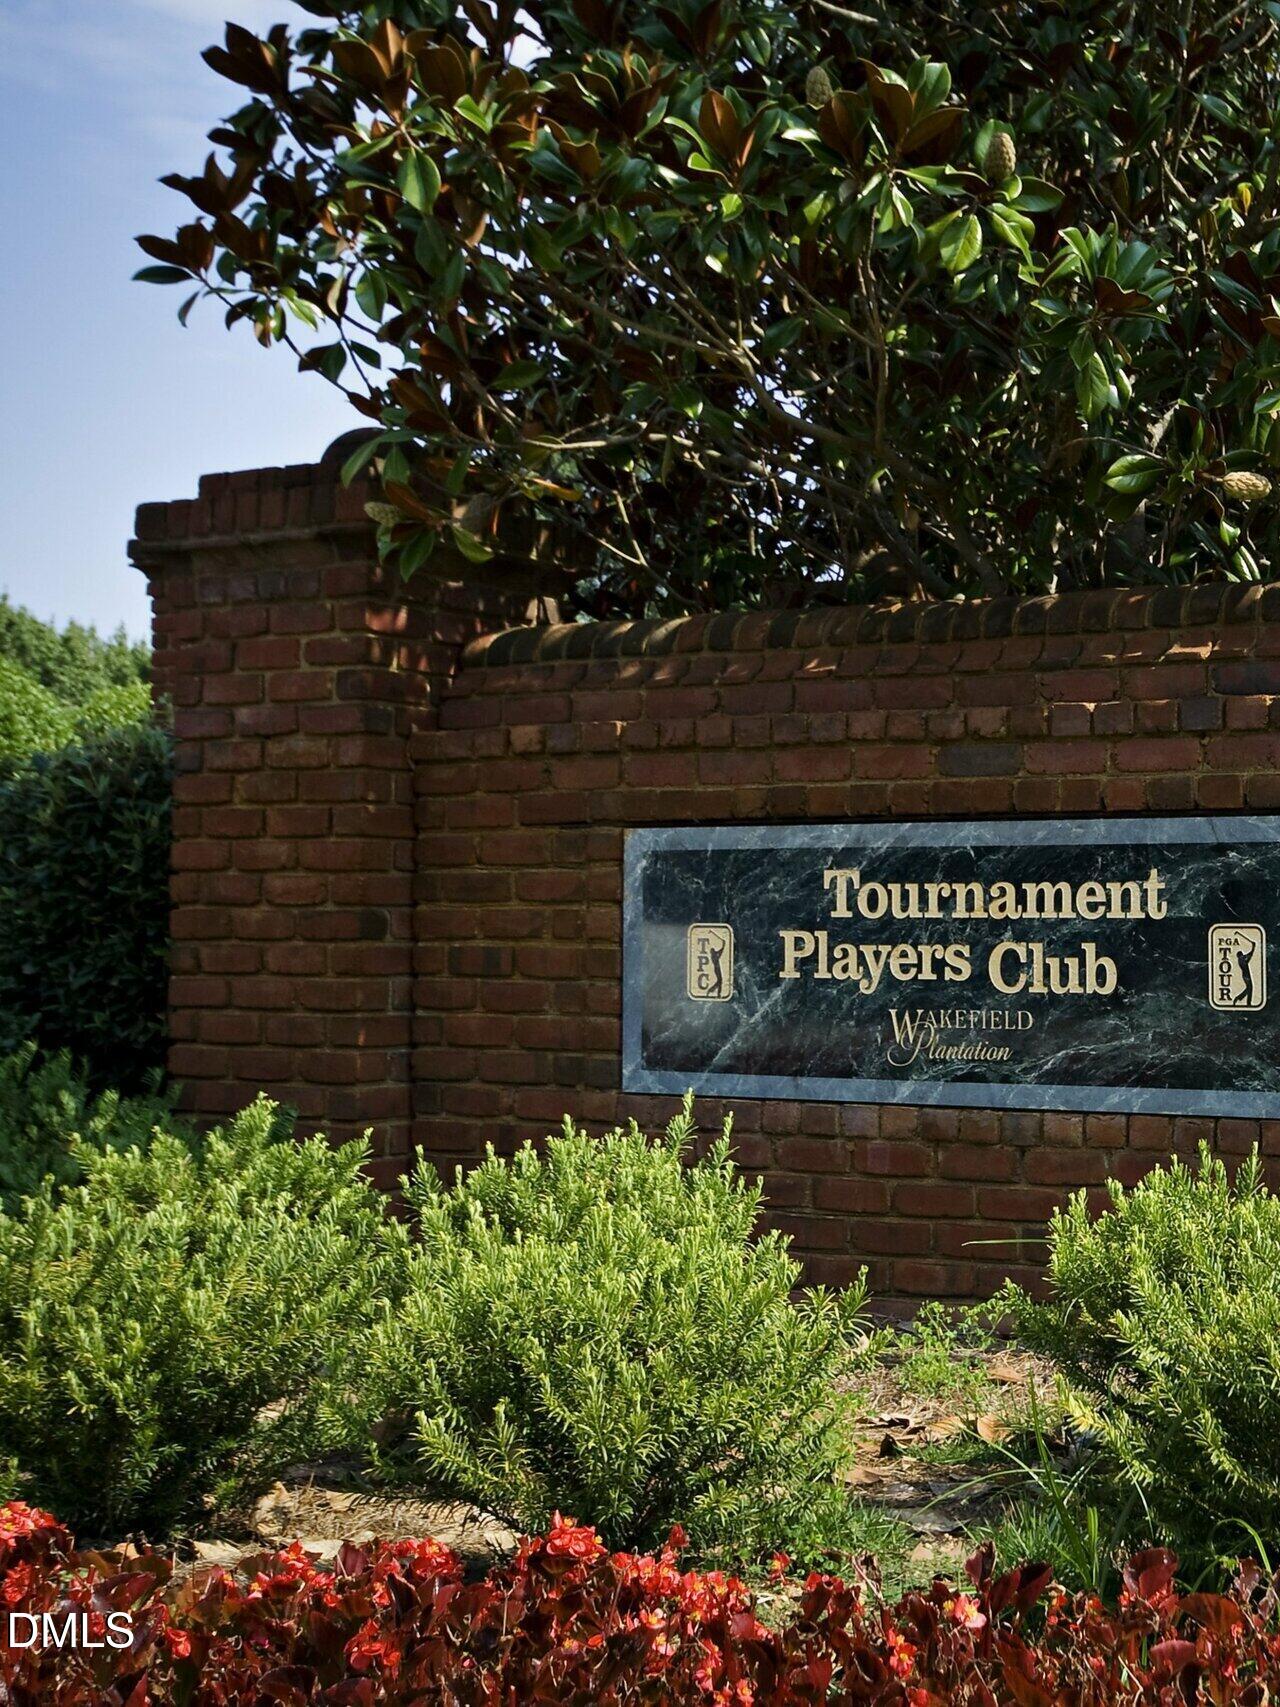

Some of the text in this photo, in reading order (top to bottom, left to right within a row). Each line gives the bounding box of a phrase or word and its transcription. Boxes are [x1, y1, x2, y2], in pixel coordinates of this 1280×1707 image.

[823, 868, 1168, 920] Tournament
[697, 937, 710, 990] TPC
[778, 930, 1118, 995] Players Club
[1218, 938, 1240, 946] PGA
[1218, 947, 1233, 1001] TOUR
[887, 1021, 1013, 1067] Plantation
